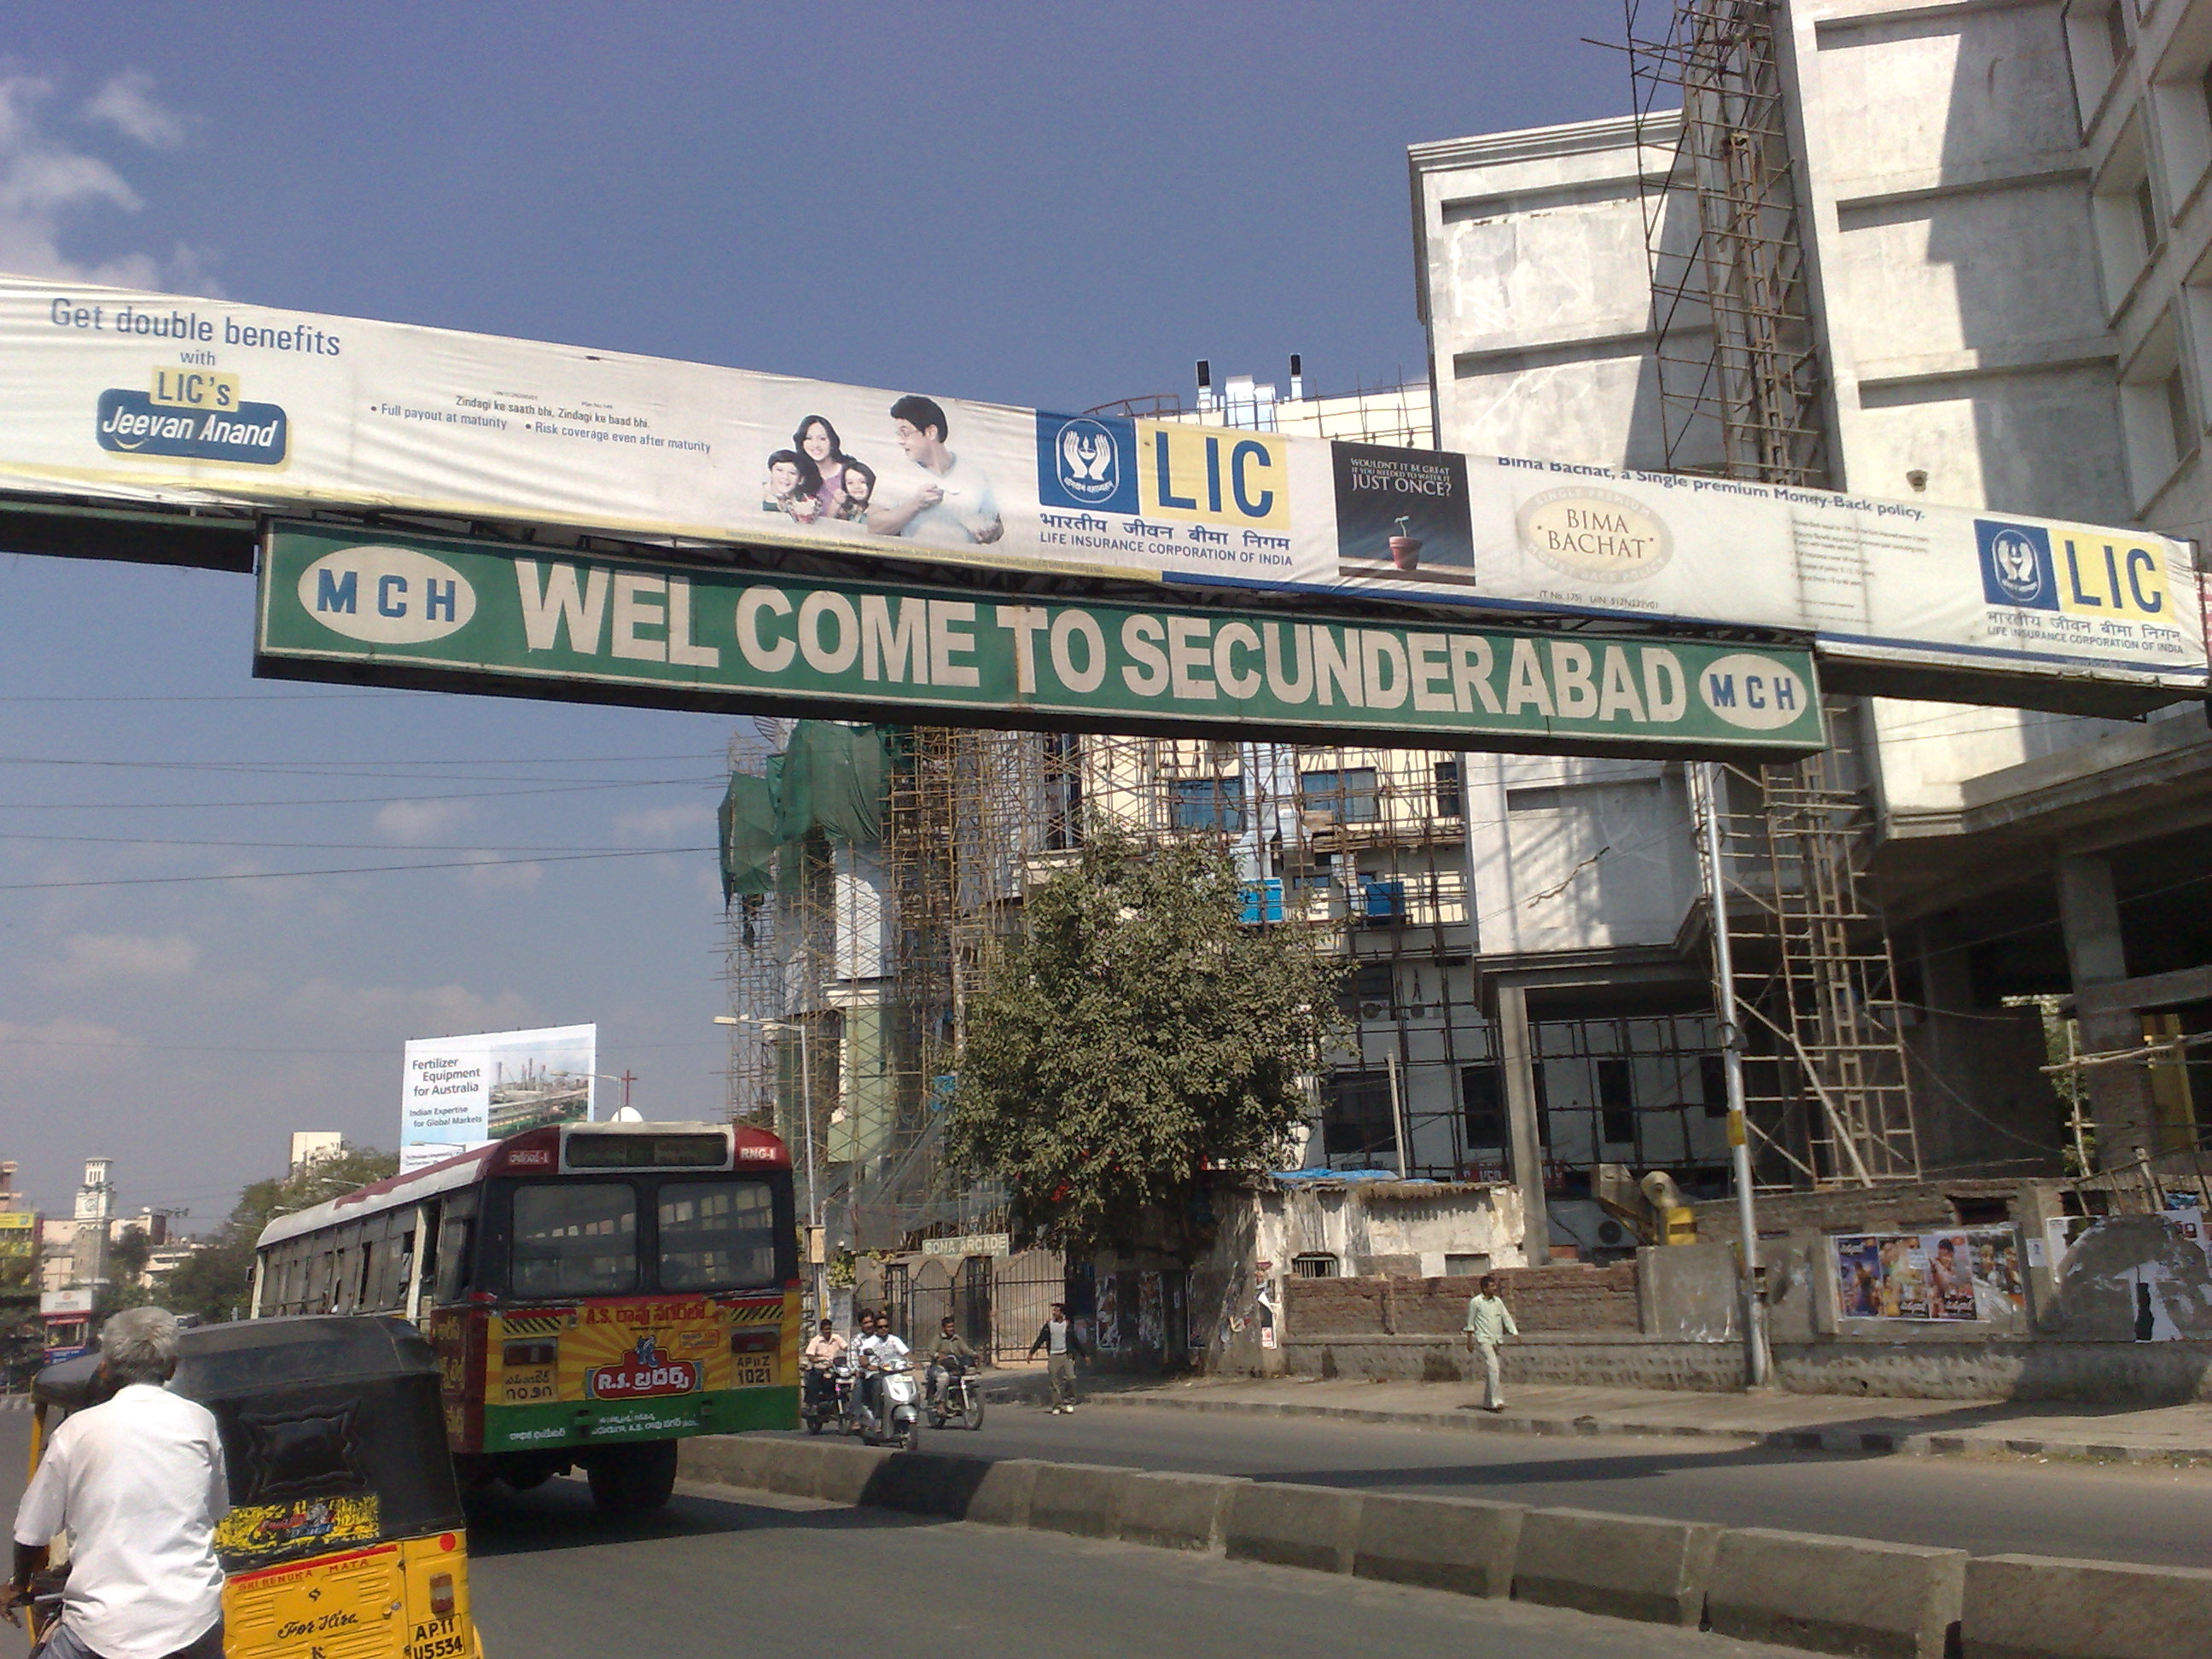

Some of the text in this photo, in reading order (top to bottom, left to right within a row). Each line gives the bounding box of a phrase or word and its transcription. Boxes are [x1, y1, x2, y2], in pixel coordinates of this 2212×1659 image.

[51, 298, 341, 356] Get double benefits
[180, 350, 216, 366] with
[158, 372, 230, 406] LIC's
[381, 404, 508, 431] Full payout at maturity
[456, 396, 491, 411] Zindagi
[494, 401, 505, 411] ke
[508, 405, 535, 416] saath
[558, 408, 592, 423] Zindagi
[595, 413, 606, 423] ke
[608, 416, 631, 427] baad
[102, 406, 278, 447] Jeevan Anand
[535, 422, 711, 454] Risk coverage even after maturity
[1155, 431, 1273, 518] LIC
[1423, 465, 1450, 475] GREAT
[1353, 474, 1452, 496] JUST ONCE?
[1498, 457, 1543, 470] Bima
[1621, 470, 1631, 480] a
[1637, 470, 1688, 488] Single
[1693, 478, 1768, 498] premium
[1773, 488, 1871, 511] Money-Back
[1877, 498, 1926, 521] policy.
[1537, 488, 1584, 505] SINGLE
[1039, 512, 1290, 550] भारतीय जीवन बीमा निगम
[1567, 509, 1629, 534] BIMA
[1040, 532, 1293, 566] LIFE INSURANCE CORPORATION OF INDIA
[1548, 530, 1644, 558] BACHAT
[2064, 540, 2162, 614] LIC
[316, 568, 457, 624] MCH
[1987, 610, 2040, 627] भारतीय
[2050, 616, 2090, 634] जीवन
[2100, 620, 2132, 637] बीमा
[1988, 626, 2007, 636] LIFE
[2011, 627, 2066, 643] INSURANCE
[2069, 634, 2138, 649] CORPORATION
[2157, 643, 2184, 655] INDIA
[997, 604, 1105, 695] TO
[1121, 613, 1687, 723] SECUNDERABAD
[1710, 672, 1797, 713] MCH
[412, 1058, 459, 1070] Fertilizer
[422, 1068, 480, 1083] Equipment
[414, 1082, 479, 1097] for Australia
[410, 1106, 469, 1117] Indian Expertise
[413, 1115, 482, 1127] for Global Markets
[741, 1148, 775, 1160] RNG-1
[924, 1236, 1006, 1254] SONA ARCADE
[586, 1308, 612, 1324] A.S.
[598, 1374, 631, 1390] R.S.
[738, 1368, 771, 1384] 1021
[329, 1558, 369, 1573] MATA
[277, 1610, 358, 1639] For Hire
[413, 1636, 463, 1659] U5534
